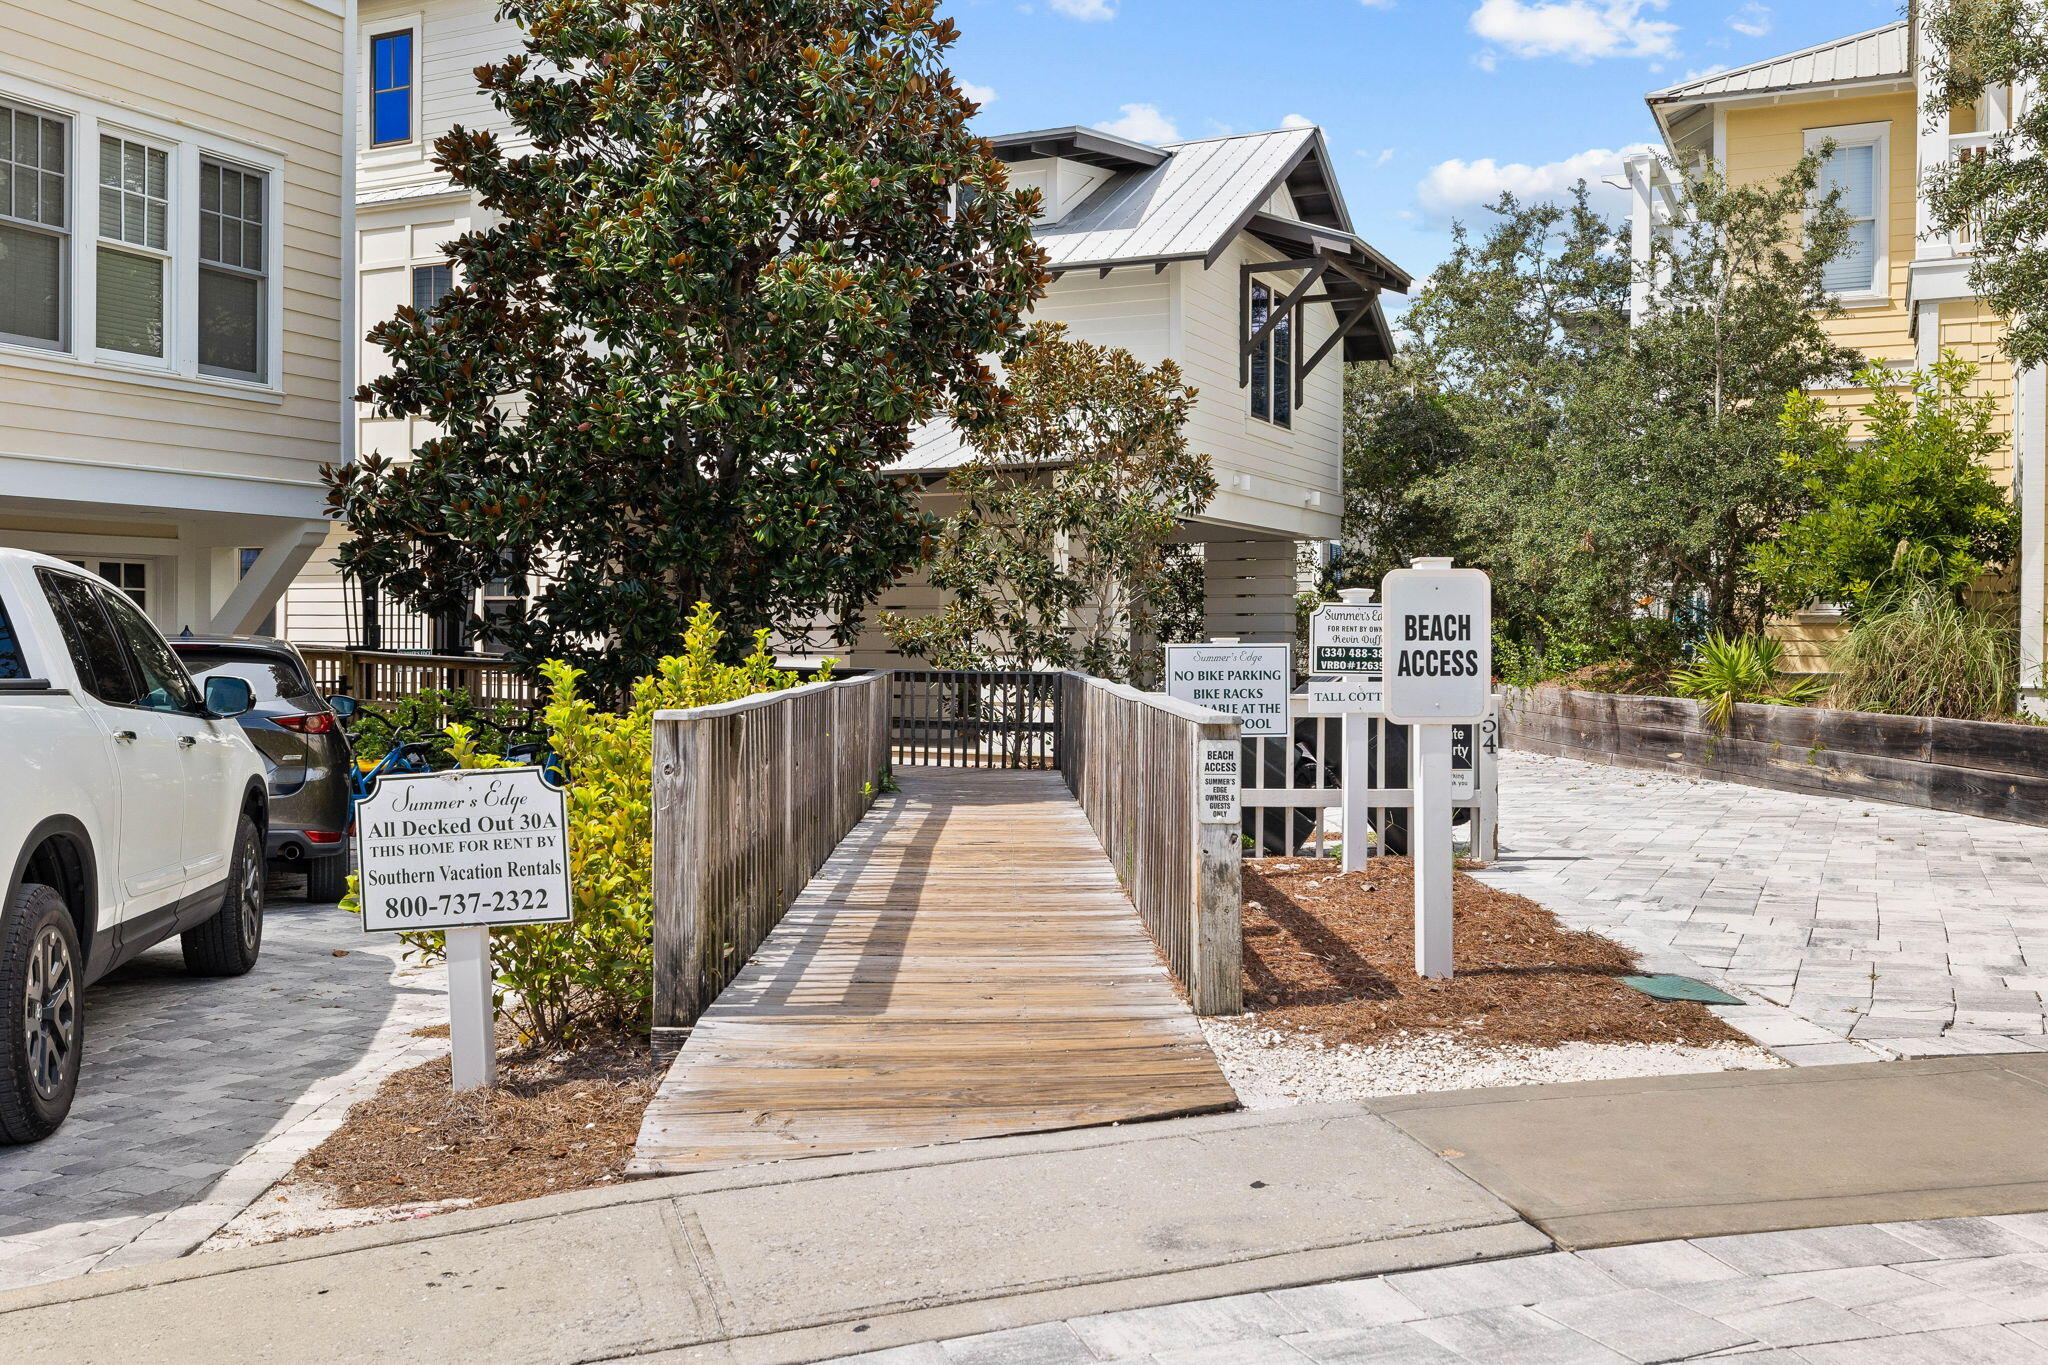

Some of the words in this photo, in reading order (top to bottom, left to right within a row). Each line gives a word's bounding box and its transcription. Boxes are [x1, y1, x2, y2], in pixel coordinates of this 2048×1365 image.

[1325, 608, 1370, 620] Summer's
[1404, 614, 1471, 641] BEACH
[1332, 634, 1359, 644] Kevin
[1362, 634, 1383, 646] Duff
[1193, 651, 1237, 662] Summer's
[1240, 650, 1263, 665] Edge
[1321, 648, 1346, 658] (334)
[1398, 650, 1478, 677] ACCESS
[1174, 670, 1194, 681] NO
[1198, 670, 1224, 680] BIKE
[1228, 670, 1281, 680] PARKING
[1193, 689, 1220, 699] BIKE
[1223, 688, 1263, 699] RACKS
[1314, 692, 1345, 701] TALL
[1348, 692, 1382, 701] COTT
[1241, 704, 1255, 713] AT
[1258, 704, 1280, 713] THE
[1208, 751, 1234, 760] BEACH
[1204, 763, 1236, 772] ACCESS
[392, 785, 477, 812] Summer's
[484, 780, 528, 813] Edge
[368, 822, 395, 838] All
[402, 818, 471, 836] Decked
[478, 816, 514, 832] Out
[520, 813, 558, 830] 30A
[370, 844, 404, 858] THIS
[409, 842, 455, 856] HOME
[459, 840, 488, 853] FOR
[493, 837, 533, 850] RENT
[537, 836, 557, 848] BY
[368, 868, 435, 886] Southern
[440, 863, 502, 881] Vacation
[508, 859, 561, 877] Rentals
[385, 888, 549, 919] 800-737-2322
